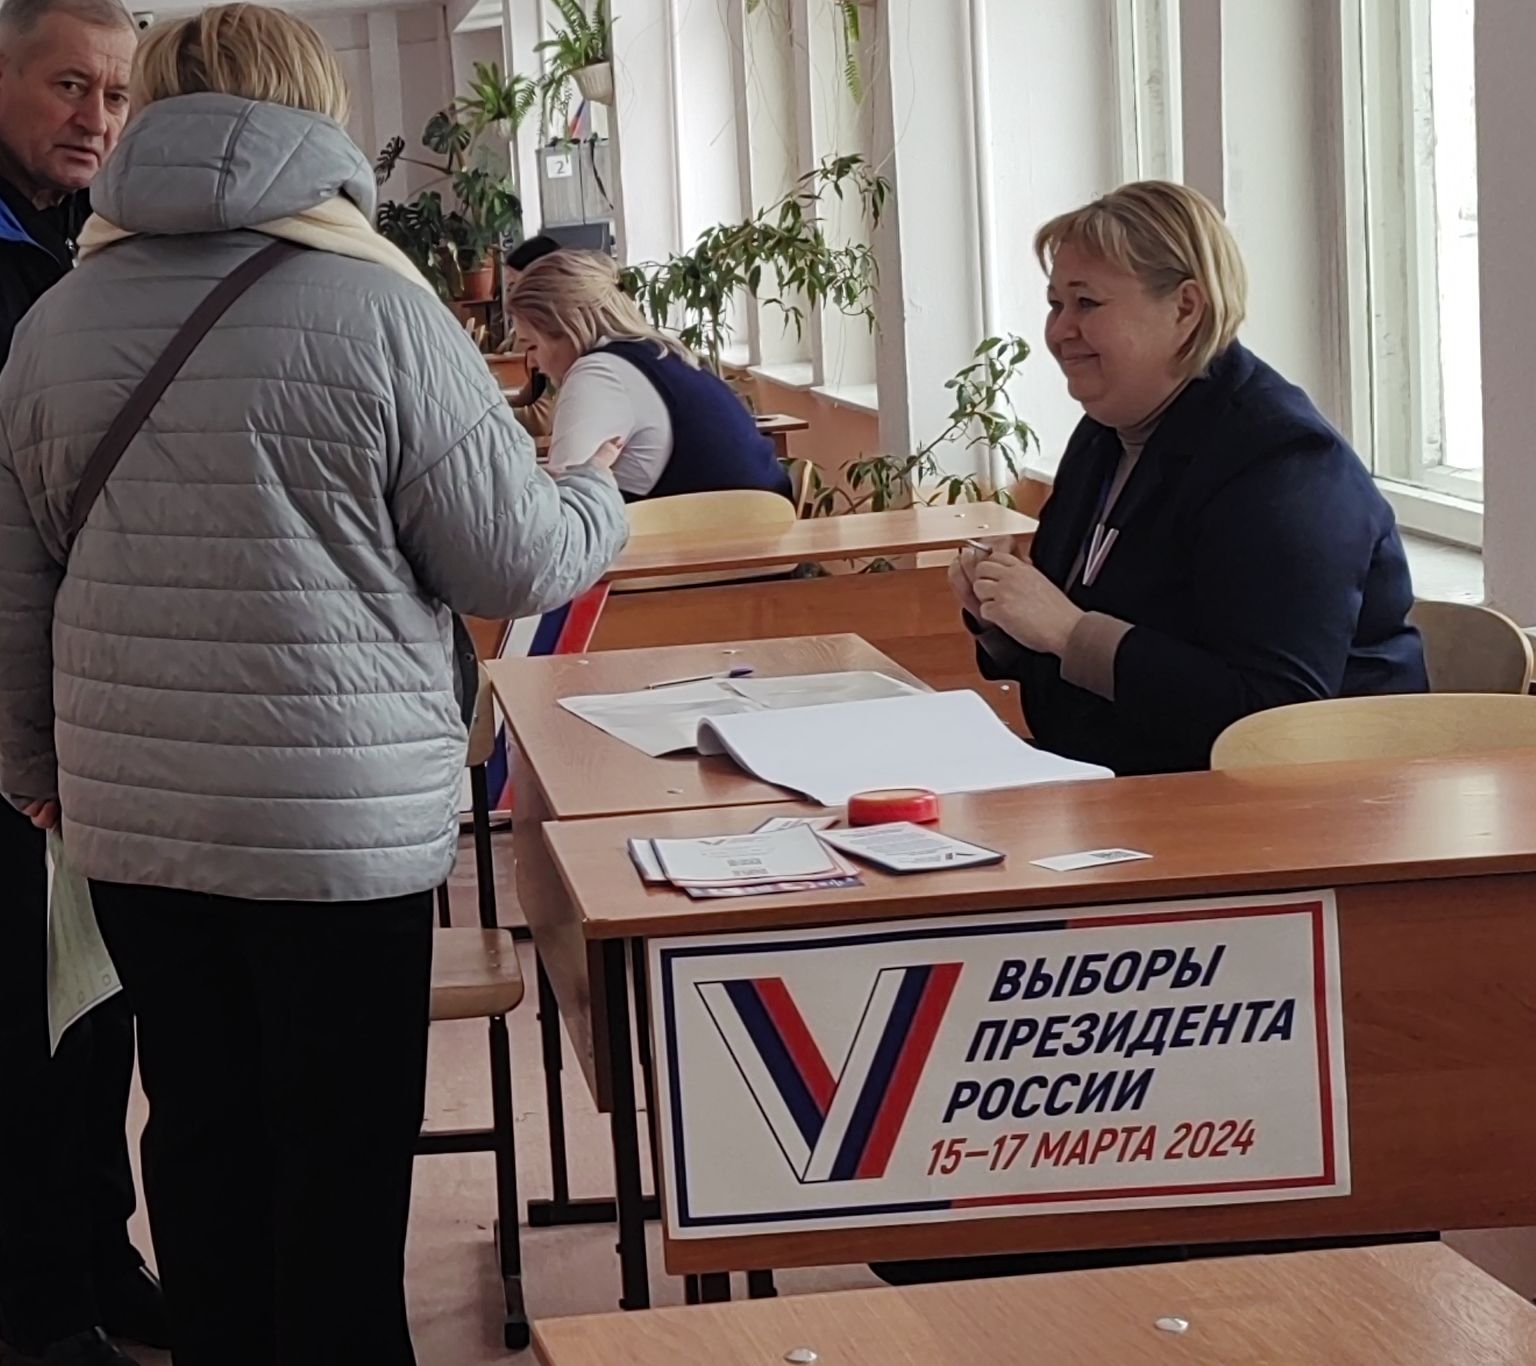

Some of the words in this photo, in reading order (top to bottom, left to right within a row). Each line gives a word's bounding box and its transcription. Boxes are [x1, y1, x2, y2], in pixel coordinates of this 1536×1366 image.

[555, 160, 566, 174] 2
[989, 945, 1226, 1002] ВЫБОРЫ
[965, 999, 1297, 1063] ПРЕЗИДЕНТА
[942, 1068, 1155, 1123] РОССИИ
[1030, 1125, 1156, 1169] МАРТА
[1164, 1119, 1255, 1161] 2024
